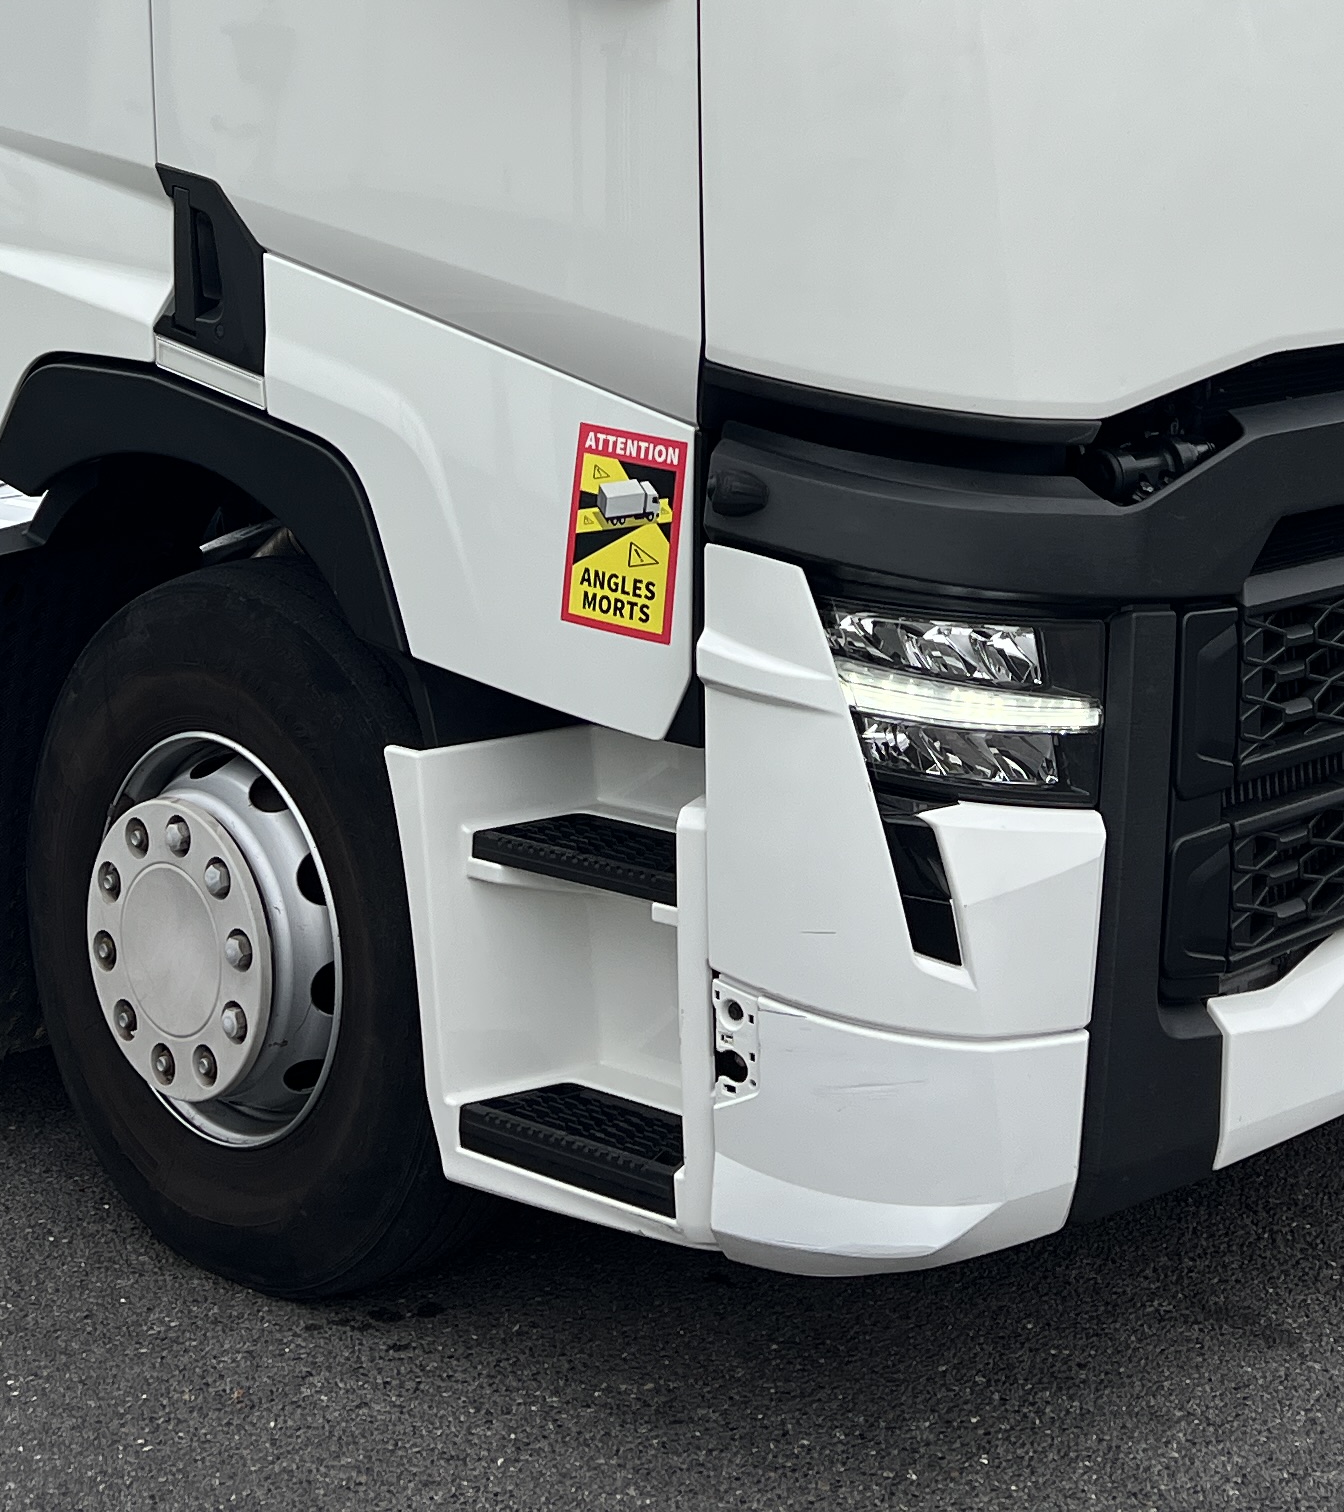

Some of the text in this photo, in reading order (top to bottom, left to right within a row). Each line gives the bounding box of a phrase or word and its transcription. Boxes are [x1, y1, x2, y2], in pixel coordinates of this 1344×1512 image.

[584, 431, 680, 466] ATTENTION
[579, 567, 656, 601] ANGLES
[581, 590, 651, 624] MORTS
